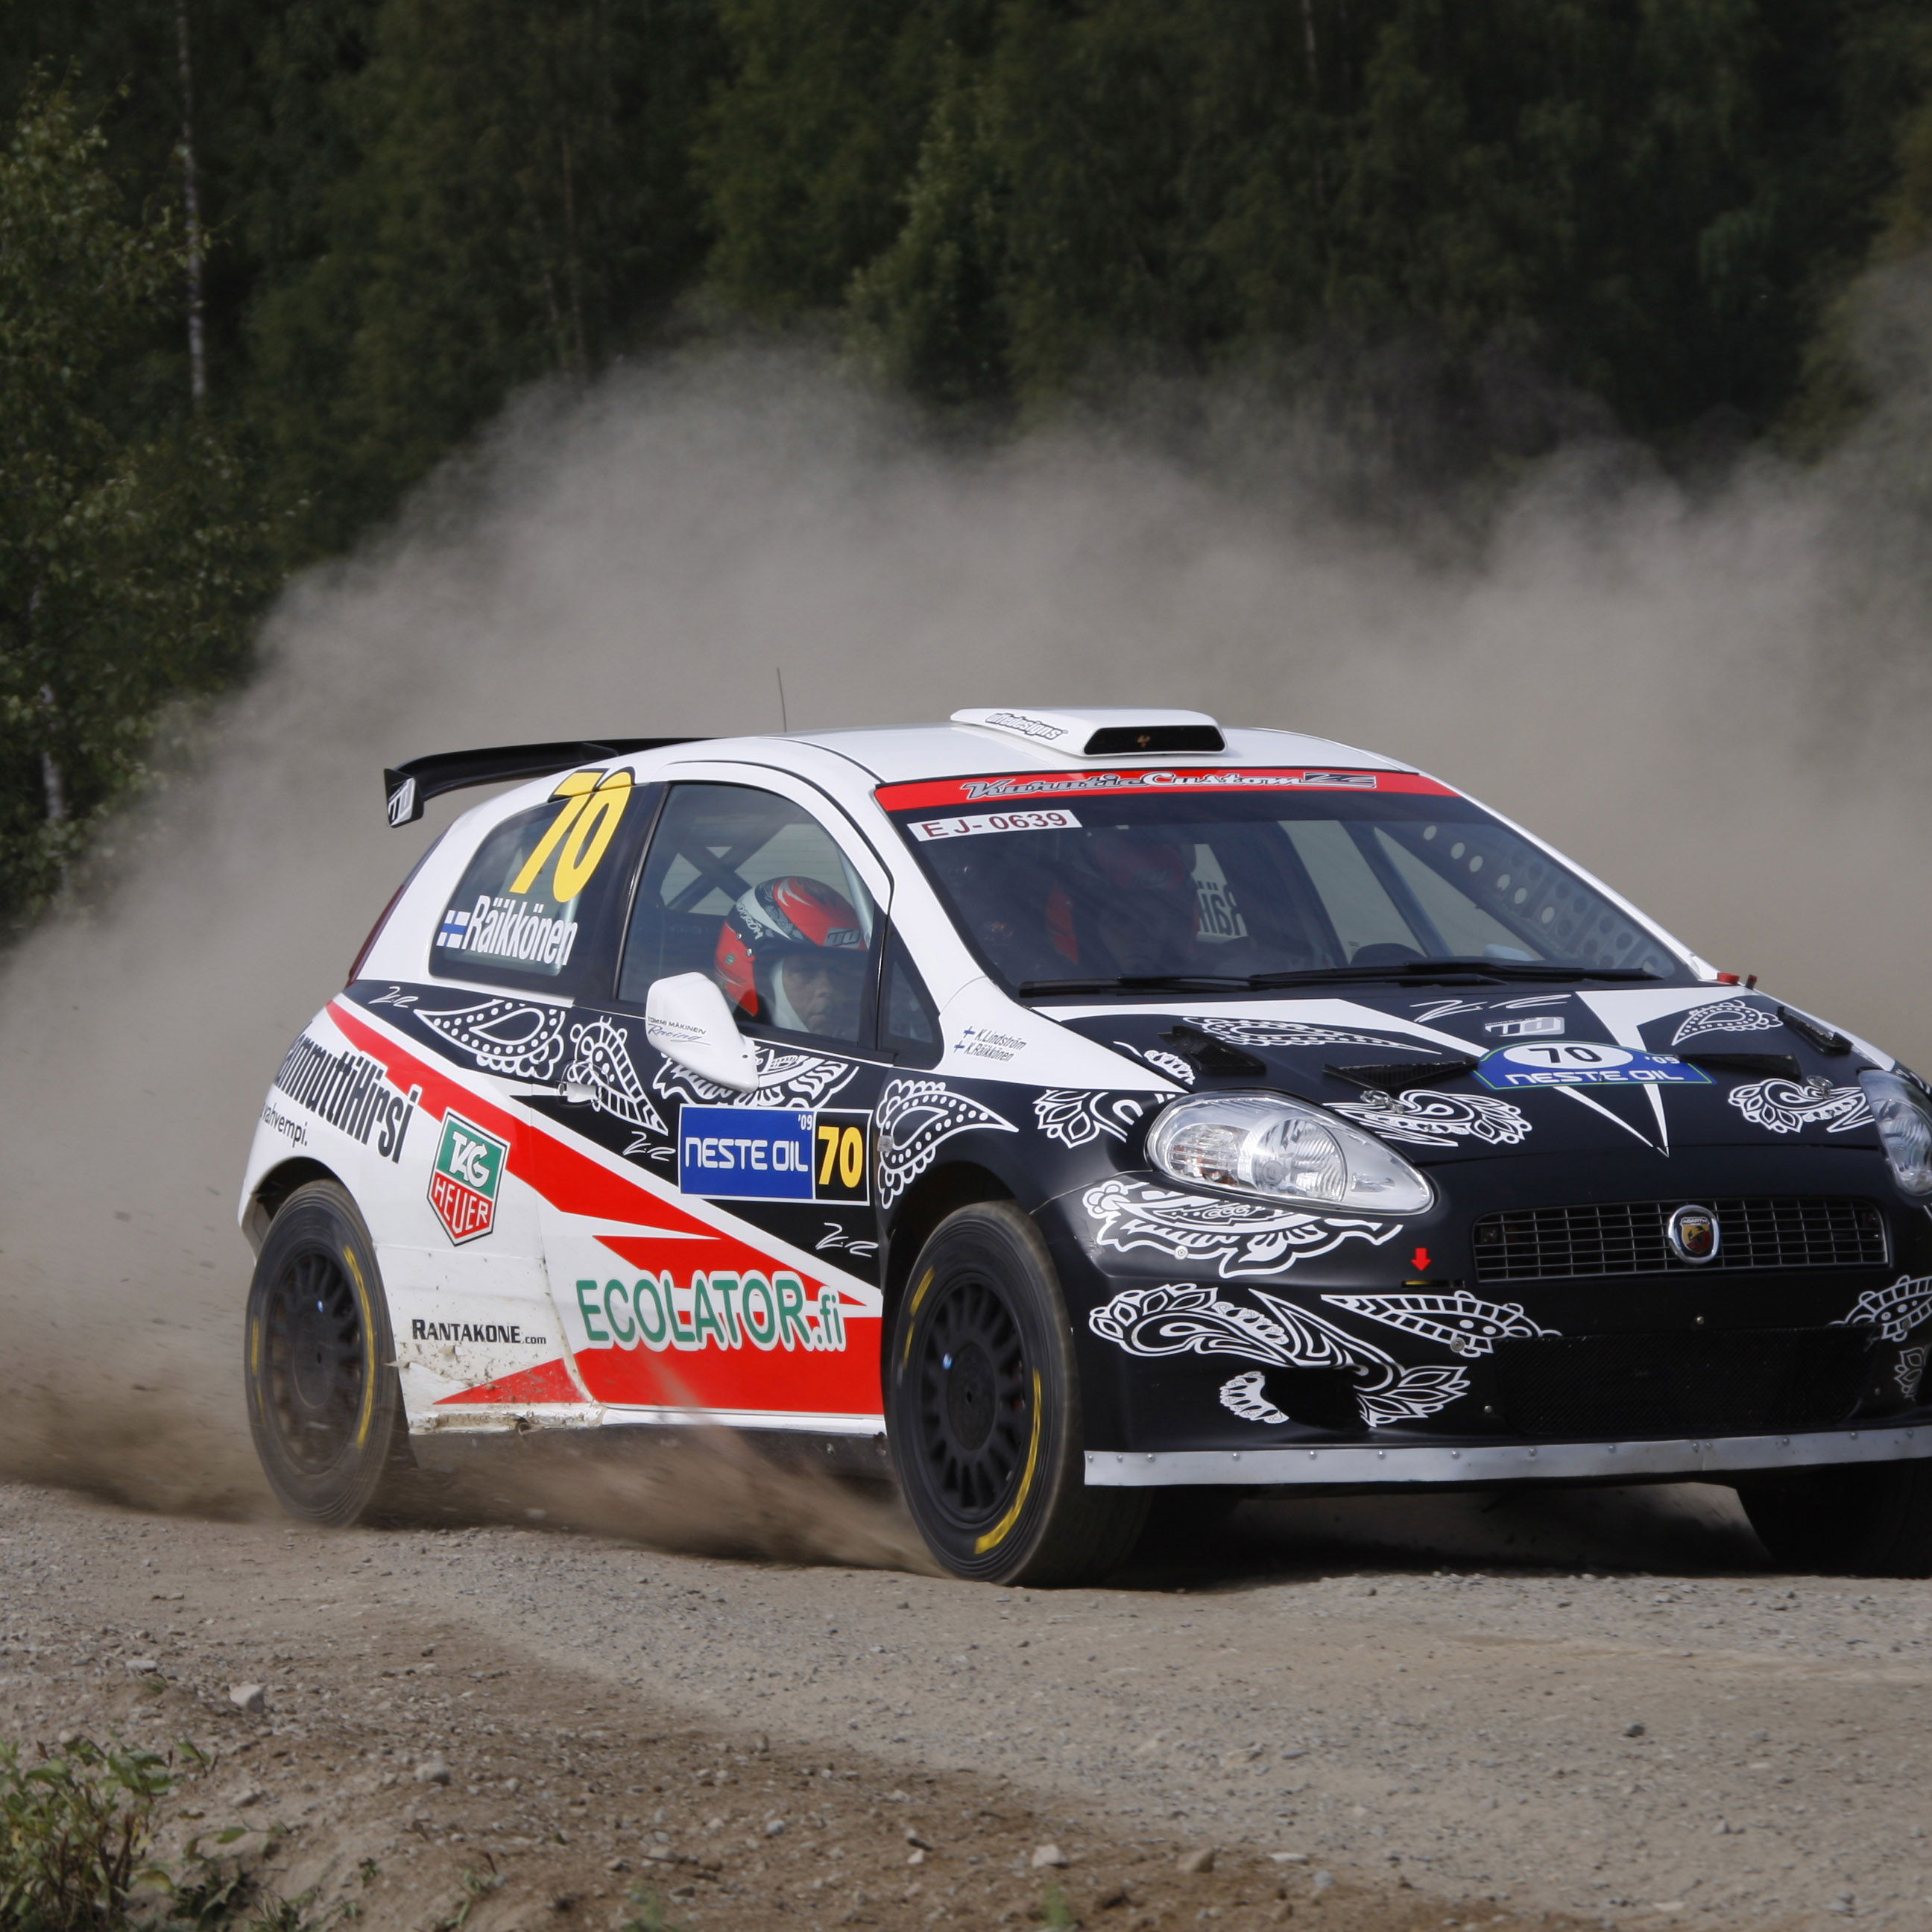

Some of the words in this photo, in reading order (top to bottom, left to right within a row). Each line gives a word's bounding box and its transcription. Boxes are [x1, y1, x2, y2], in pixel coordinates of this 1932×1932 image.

[509, 767, 635, 903] 70
[461, 895, 578, 966] Räikkönen
[648, 1023, 702, 1041] Racing
[1527, 1046, 1603, 1064] 70
[1504, 1070, 1629, 1085] NESTE
[1628, 1070, 1685, 1081] OIL
[798, 1114, 812, 1131] '09
[449, 1131, 490, 1187] TAG
[685, 1137, 768, 1171] NESTE
[772, 1140, 809, 1172] OIL
[818, 1126, 863, 1188] 70
[435, 1177, 489, 1234] HEUER
[575, 1278, 845, 1345] ECOLATOR.fi
